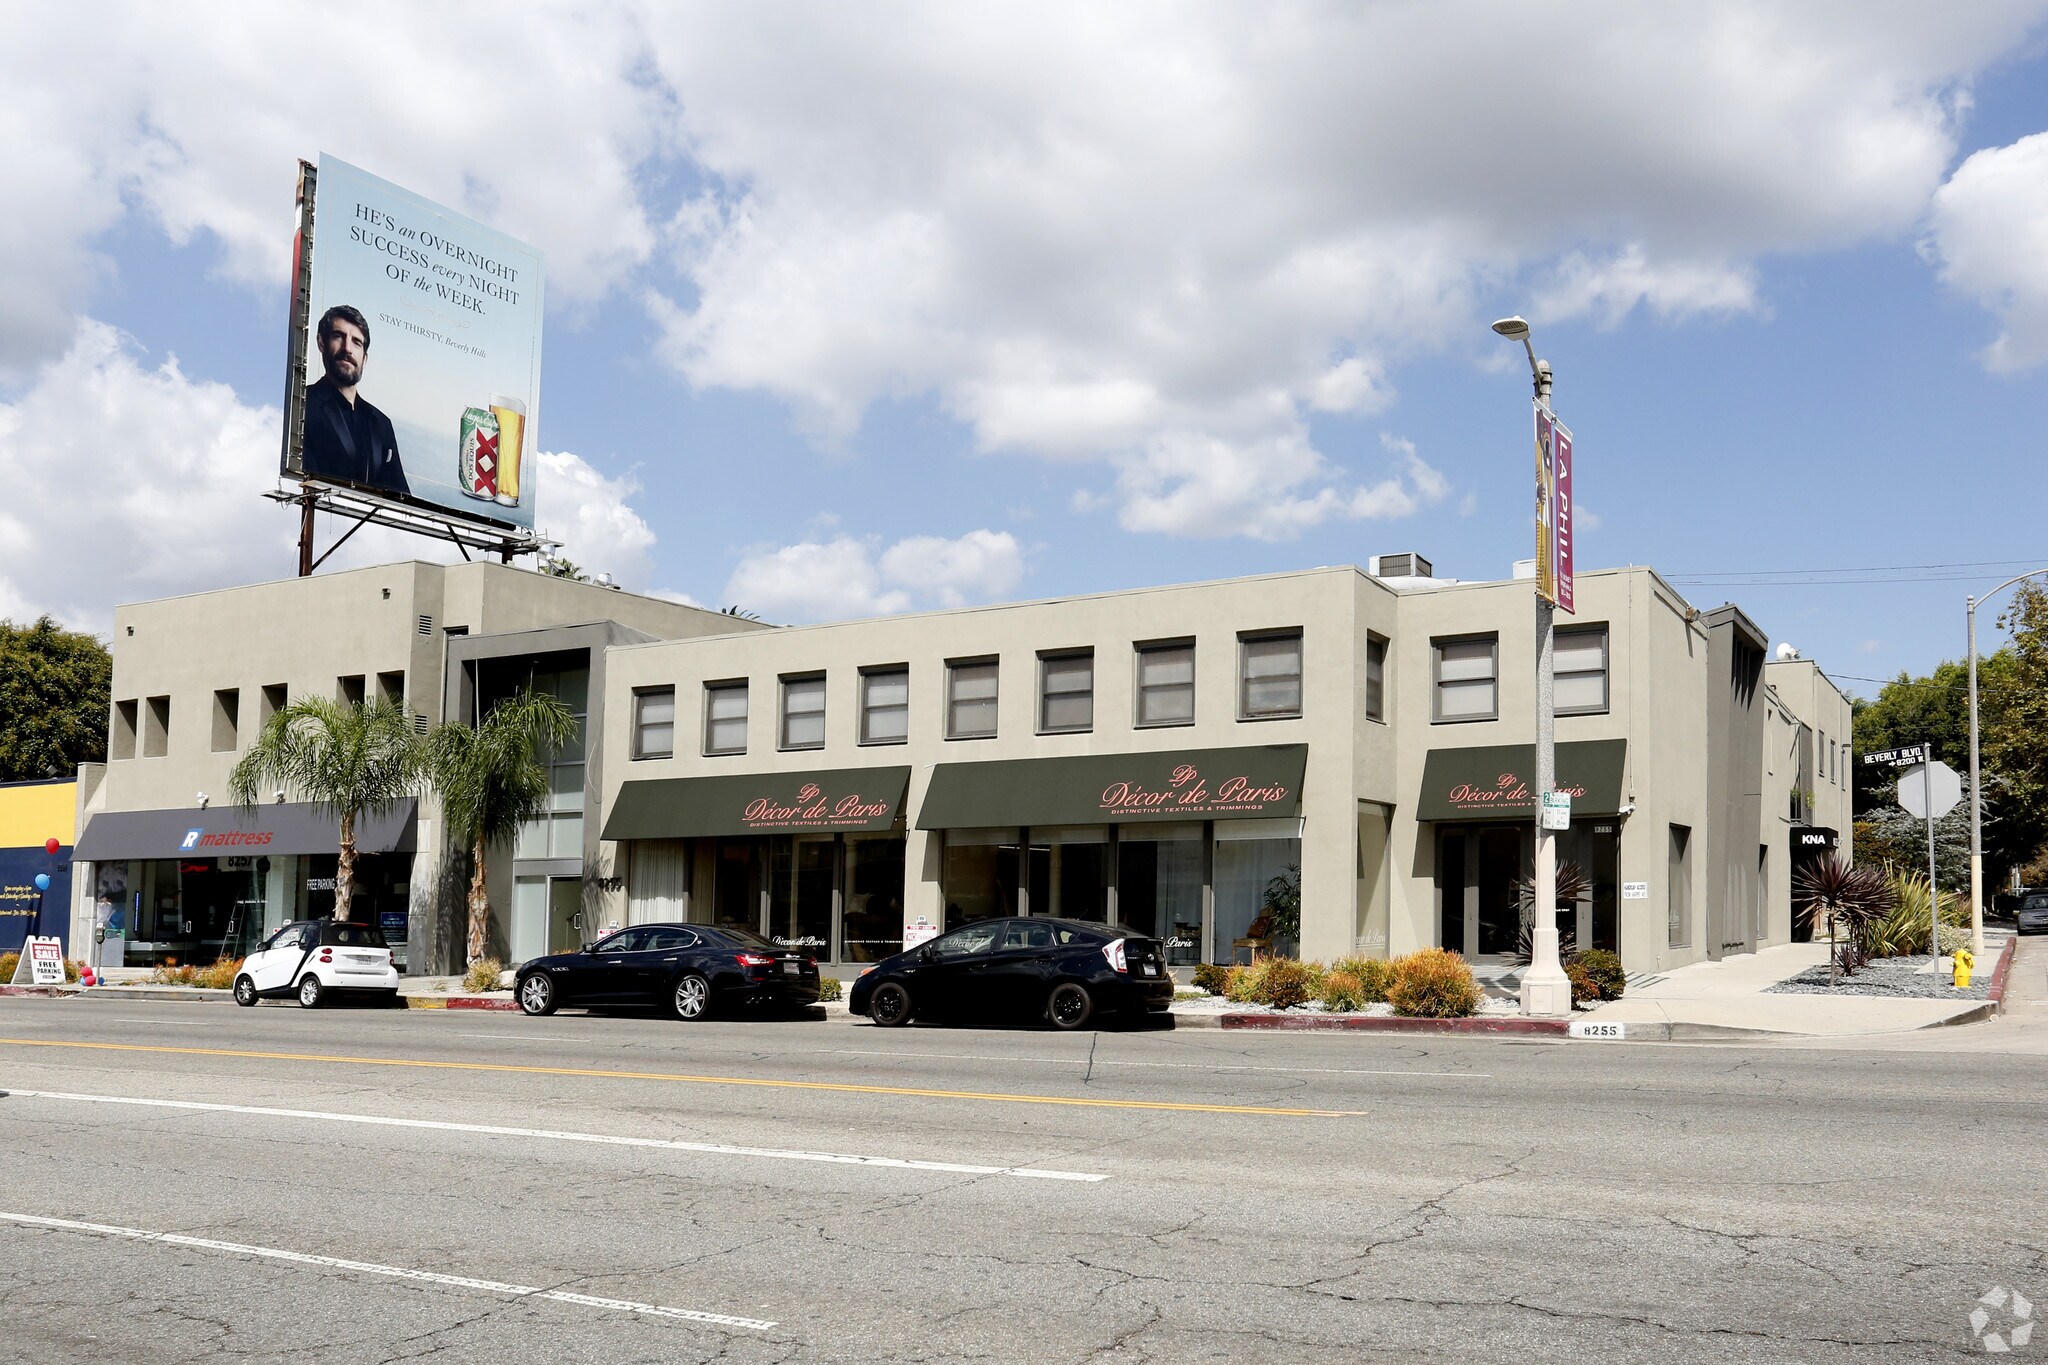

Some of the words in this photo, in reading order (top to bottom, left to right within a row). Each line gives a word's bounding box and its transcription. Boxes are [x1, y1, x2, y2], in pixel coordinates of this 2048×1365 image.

[355, 203, 395, 231] HE'S
[399, 226, 416, 240] an
[420, 231, 519, 283] OVERNIGHT
[350, 225, 429, 269] SUCCESS
[432, 262, 465, 286] every
[469, 274, 520, 305] NIGHT
[386, 264, 411, 283] OF
[413, 276, 432, 293] the
[436, 283, 486, 315] WEEK.
[379, 312, 402, 327] STAY
[403, 322, 444, 344] THIRSTY,
[445, 337, 470, 353] Beverly
[471, 346, 487, 359] Hills
[1559, 440, 1569, 479] LA
[1559, 492, 1569, 566] PHIL
[1864, 751, 1898, 764] BEVERLY
[1901, 747, 1924, 758] BLVD.
[1896, 757, 1916, 766] 8200
[1100, 781, 1175, 807] Décor
[1178, 779, 1209, 804] de
[1211, 776, 1288, 802] Paris
[1449, 784, 1504, 803] Décor
[1506, 783, 1529, 800] de
[742, 797, 802, 821] Décor
[803, 796, 828, 818] de
[828, 794, 889, 818] Paris
[200, 830, 274, 847] mattress
[1801, 834, 1826, 845] KNA
[307, 879, 317, 890] FREE
[318, 878, 335, 890] PARKING
[805, 935, 827, 946] Paris
[1165, 936, 1194, 948] Paris
[35, 950, 59, 960] SALE
[1584, 1025, 1617, 1036] 8255
